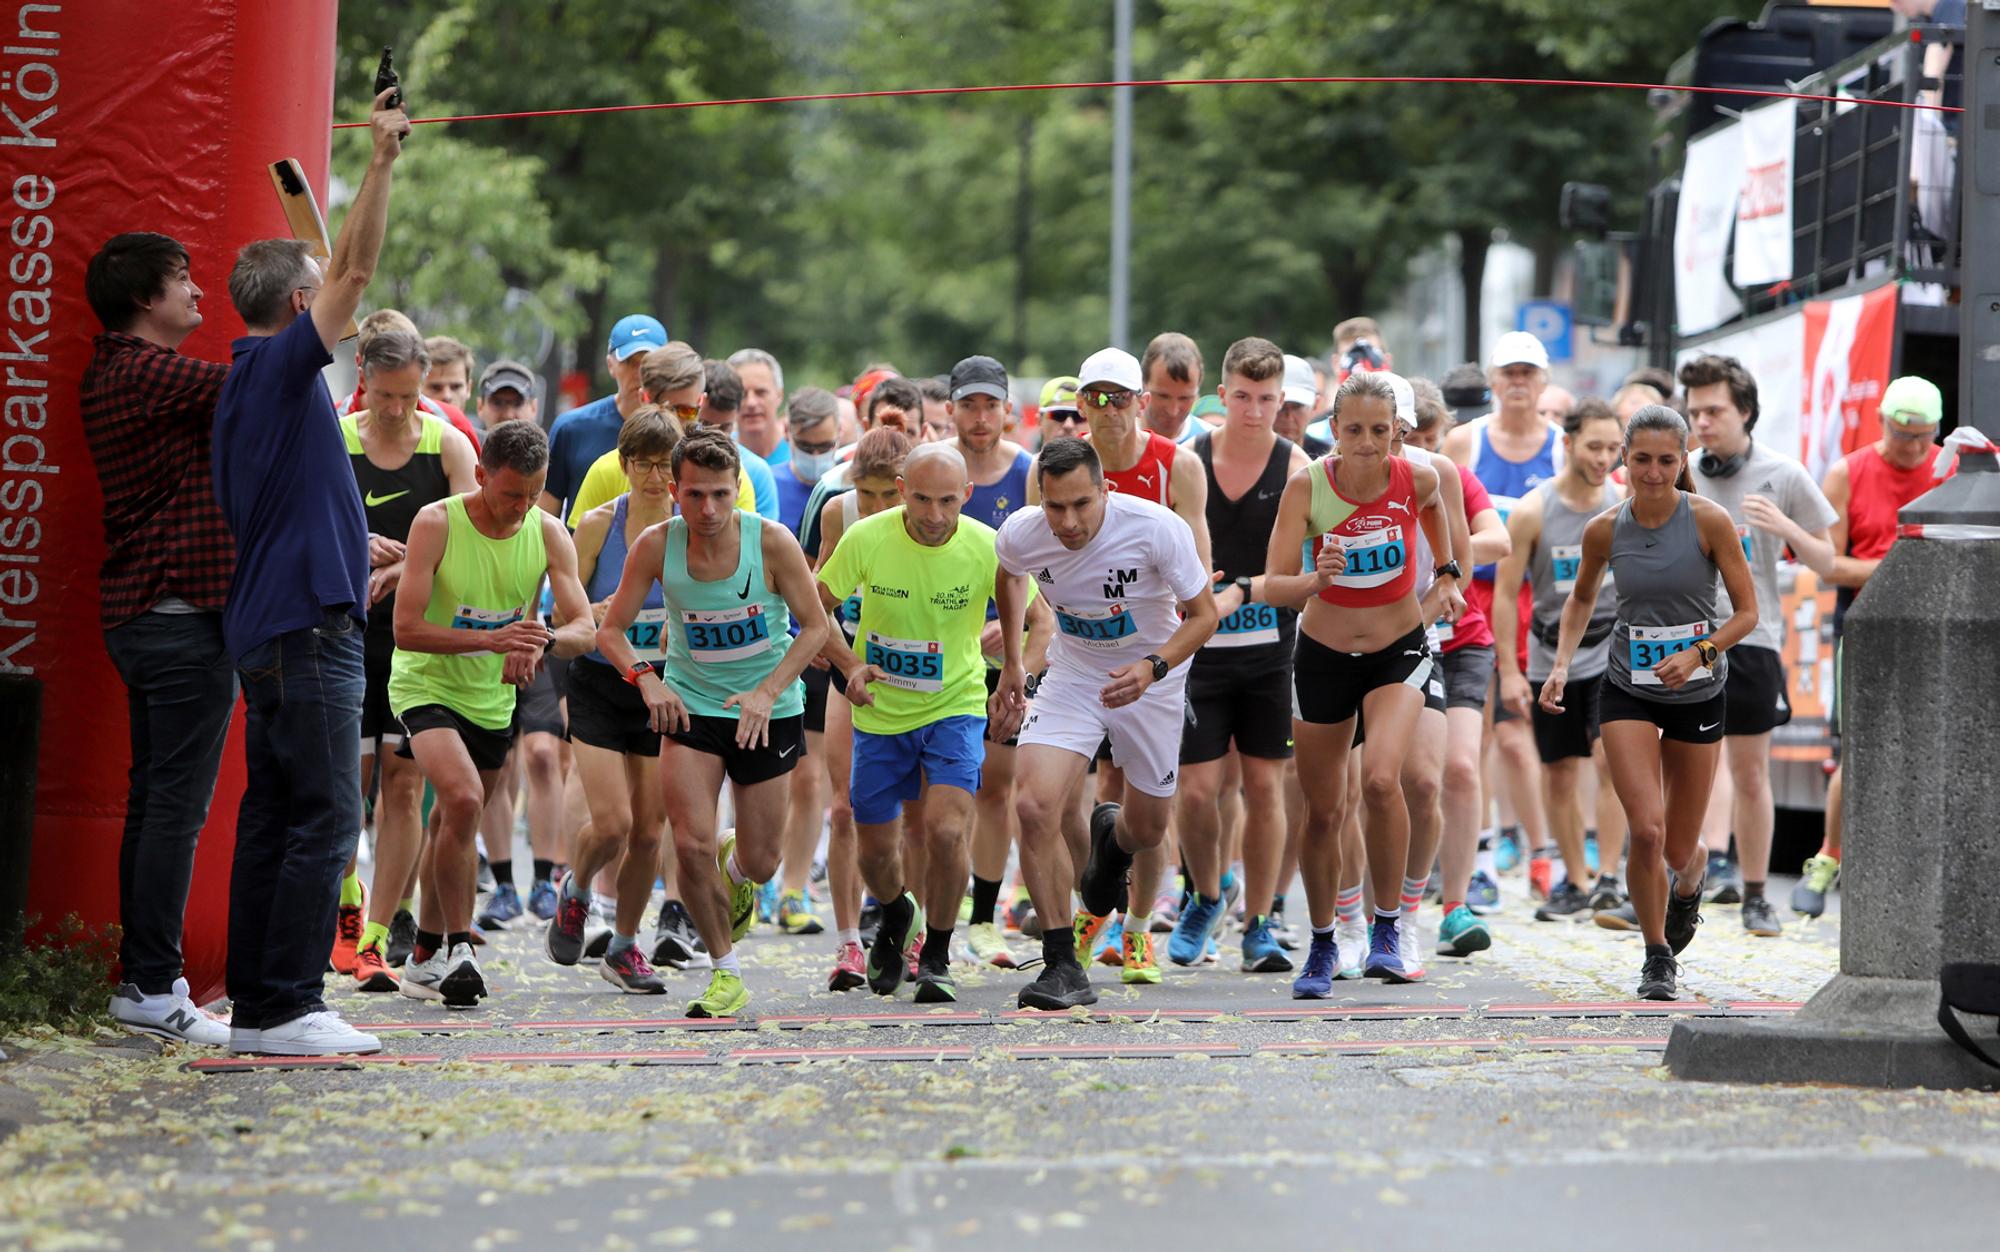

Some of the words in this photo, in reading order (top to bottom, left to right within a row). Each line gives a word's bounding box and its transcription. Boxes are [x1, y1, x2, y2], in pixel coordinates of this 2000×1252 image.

[0, 4, 61, 147] Köln
[692, 619, 763, 648] 3101
[1062, 615, 1126, 638] 3017
[1082, 640, 1120, 648] Michael
[1636, 639, 1703, 668] 31
[871, 646, 938, 677] 3035
[888, 675, 918, 688] Jimmy
